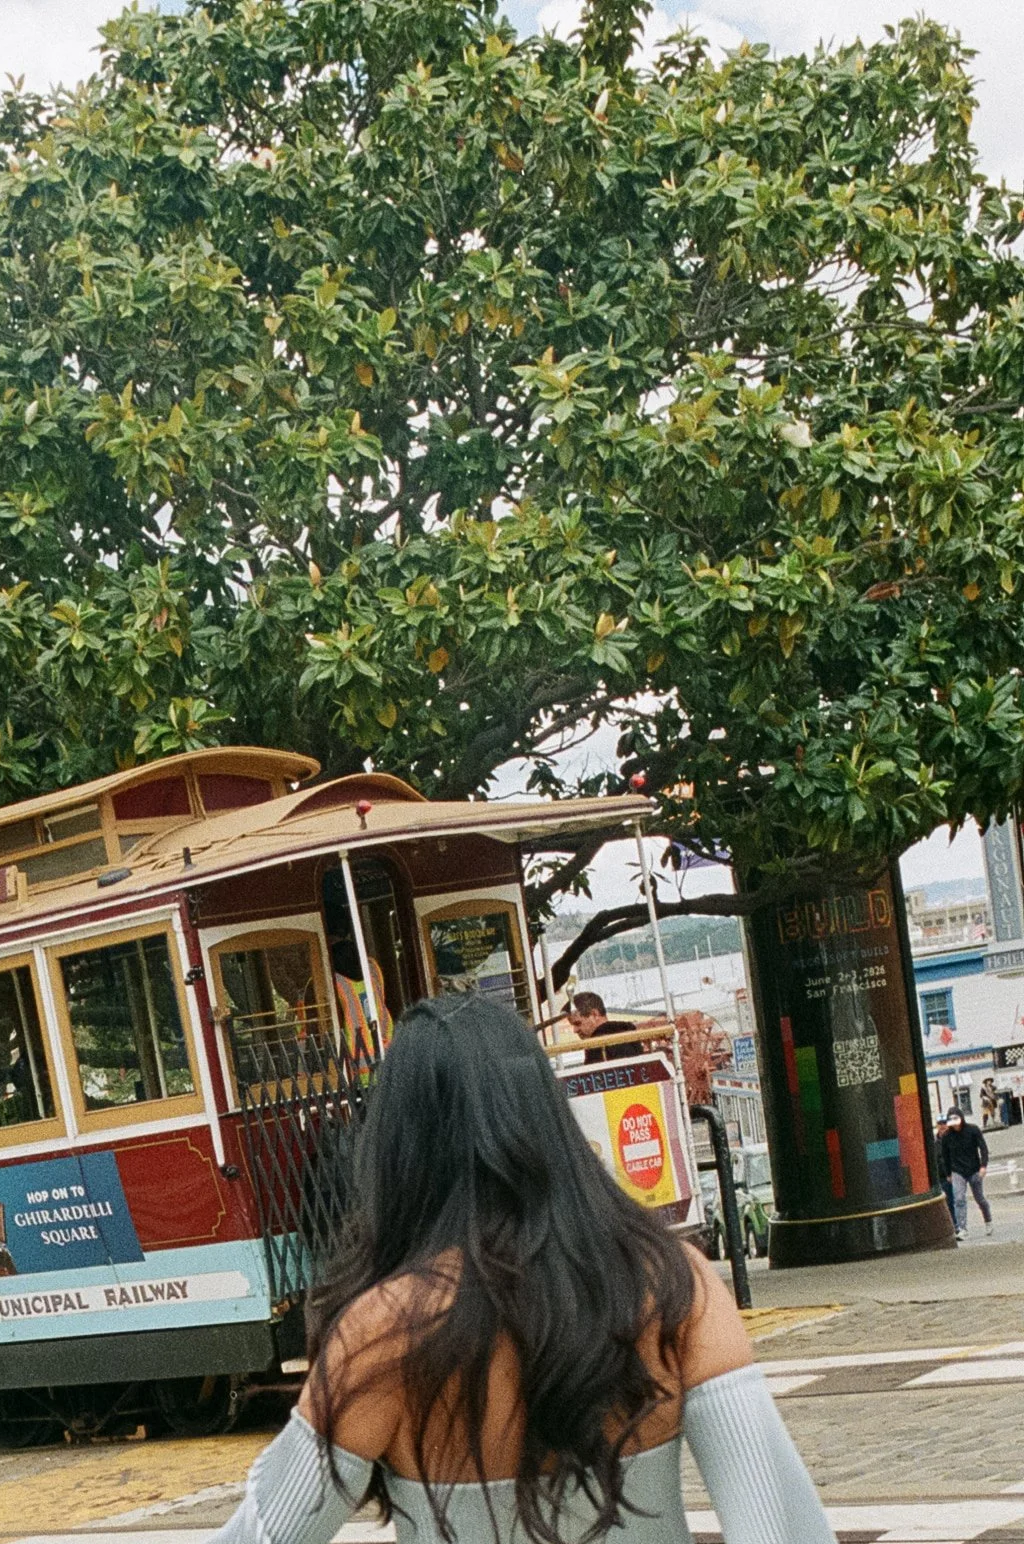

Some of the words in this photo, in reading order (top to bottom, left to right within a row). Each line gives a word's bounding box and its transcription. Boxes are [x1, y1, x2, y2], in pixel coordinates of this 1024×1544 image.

[991, 830, 1013, 939] RGONAUT
[777, 890, 892, 945] BUILD
[860, 945, 890, 958] BUILD
[805, 975, 832, 988] June
[806, 989, 826, 999] San
[832, 979, 887, 995] Francisco
[566, 1068, 636, 1097] STREET
[623, 1117, 635, 1131] DO
[636, 1114, 653, 1128] NOT
[630, 1128, 651, 1142] PASS
[626, 1161, 648, 1173] CABLE
[649, 1159, 662, 1170] CAR
[27, 1189, 49, 1205] HOP
[52, 1187, 68, 1201] ON
[70, 1185, 85, 1198] TO
[14, 1201, 114, 1229] GHIRARDELLI
[41, 1224, 99, 1248] SQUARE
[104, 1281, 189, 1307] RAILWAY
